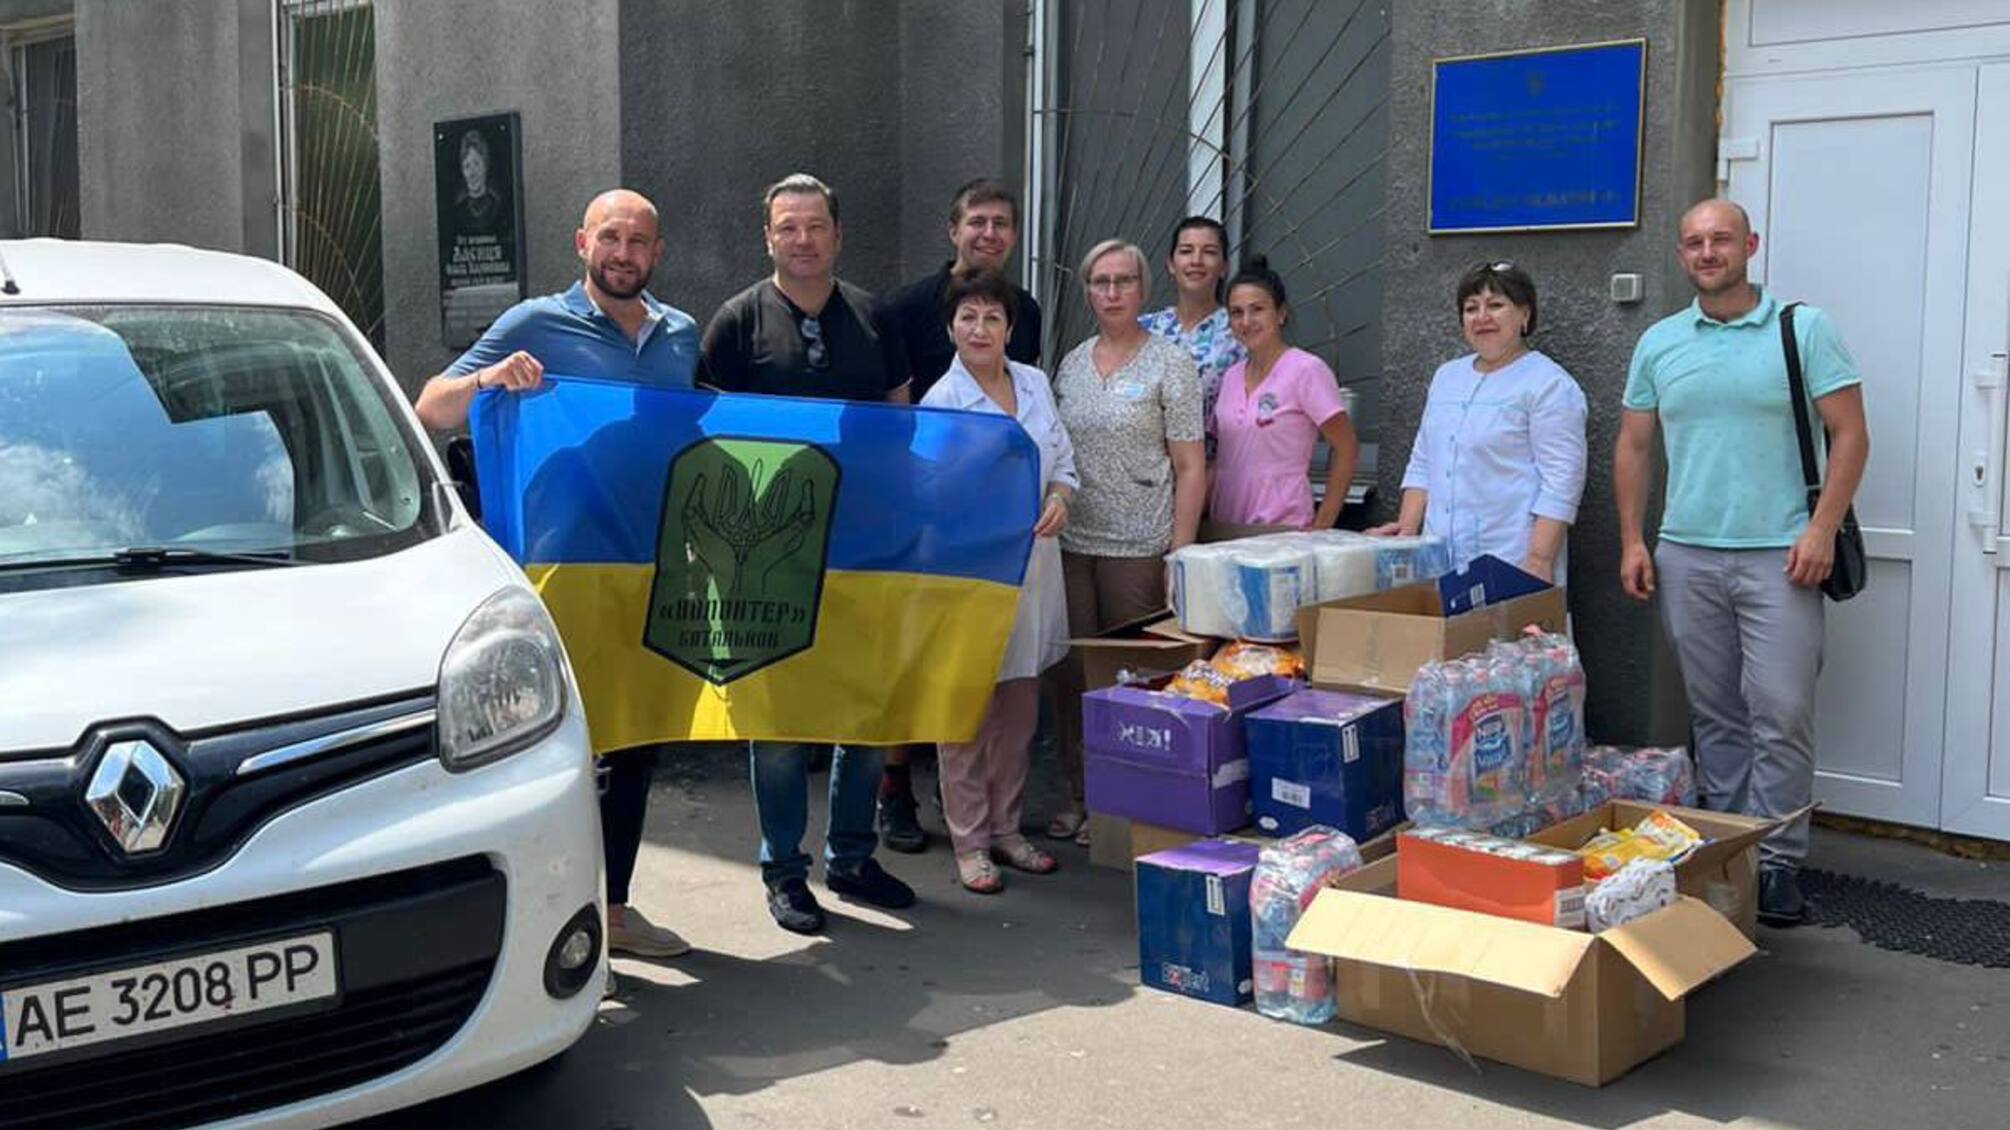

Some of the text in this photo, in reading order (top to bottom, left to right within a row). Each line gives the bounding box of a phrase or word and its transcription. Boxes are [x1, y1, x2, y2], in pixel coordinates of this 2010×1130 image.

[14, 944, 319, 1047] AE 3208 PP
